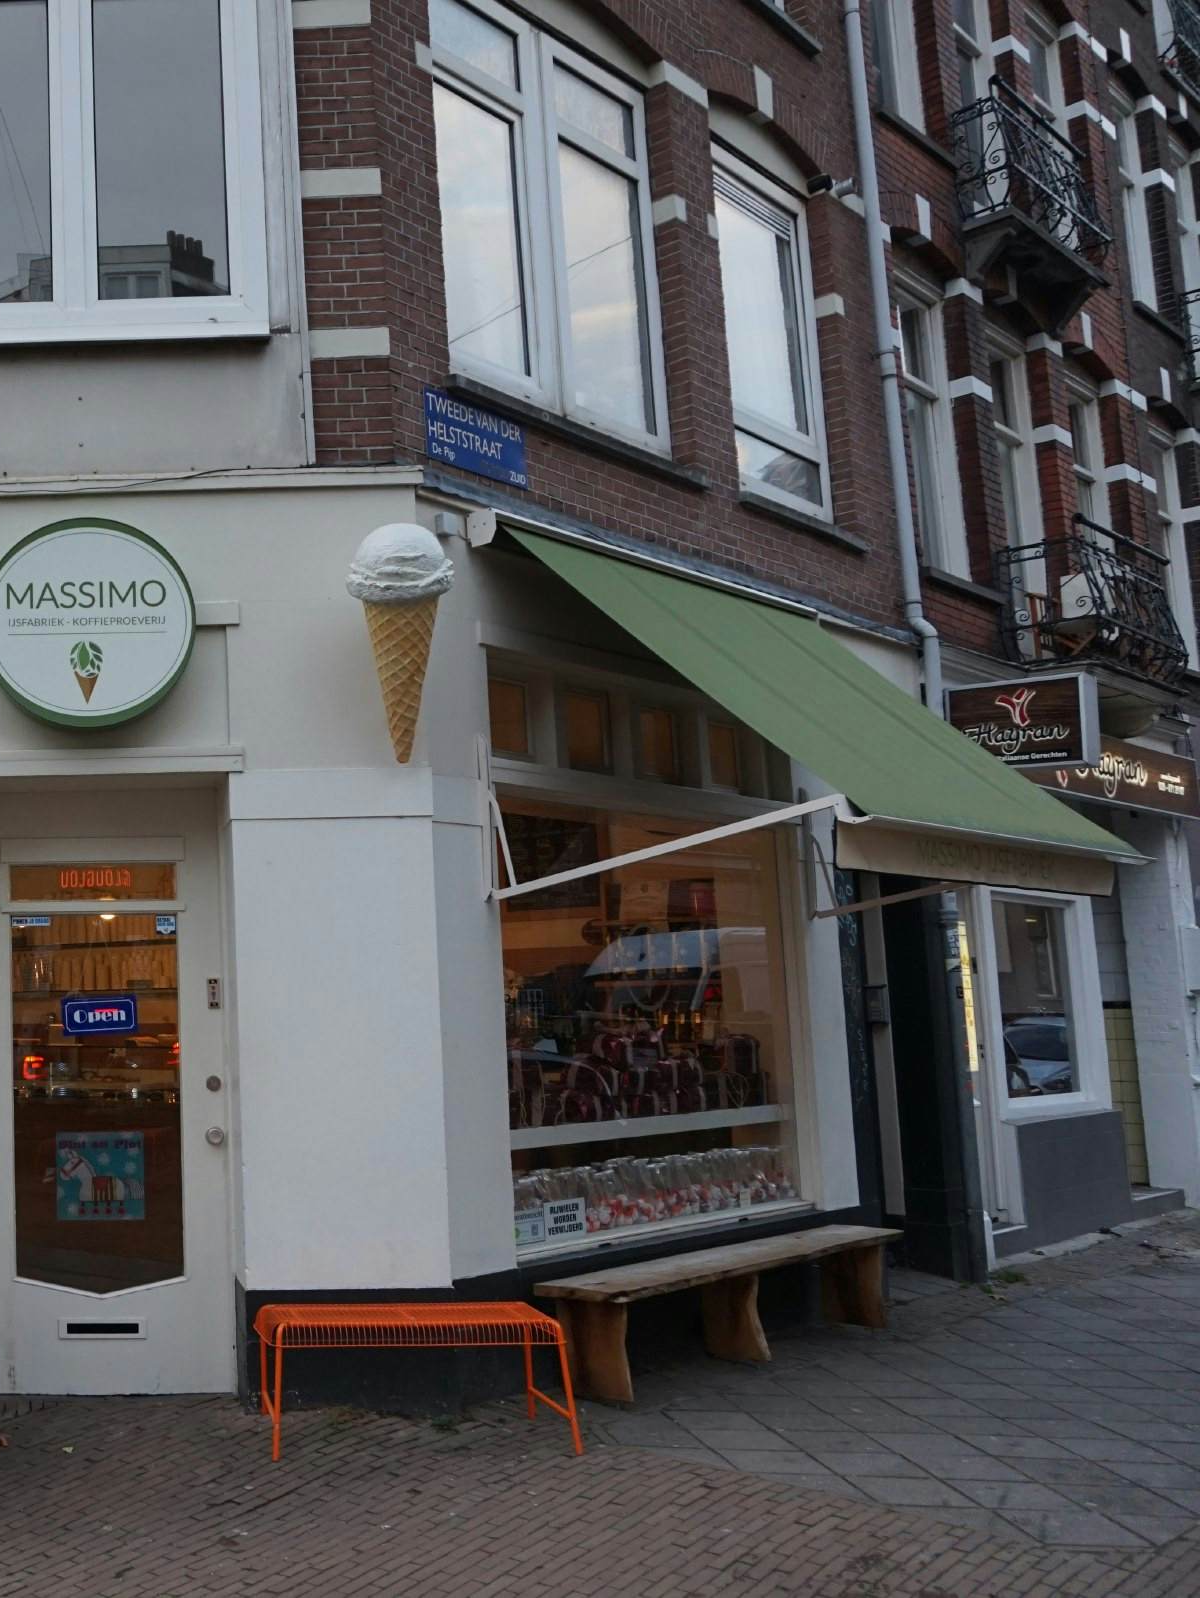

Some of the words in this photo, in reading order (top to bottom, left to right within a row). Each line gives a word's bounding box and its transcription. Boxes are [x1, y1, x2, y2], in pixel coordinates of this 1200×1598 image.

[426, 392, 475, 426] TWEEDE
[475, 408, 498, 435] VAN
[500, 420, 522, 443] DER
[427, 418, 503, 460] HELSTSTRAAT
[432, 442, 442, 456] De
[510, 470, 526, 485] ZUID
[6, 579, 167, 610] MASSIMO
[8, 617, 65, 628] IJSFABRIEK
[72, 615, 167, 627] KOFFIEPROEVERIJ
[963, 722, 1070, 755] Hayran
[553, 1213, 577, 1225] WORDEN
